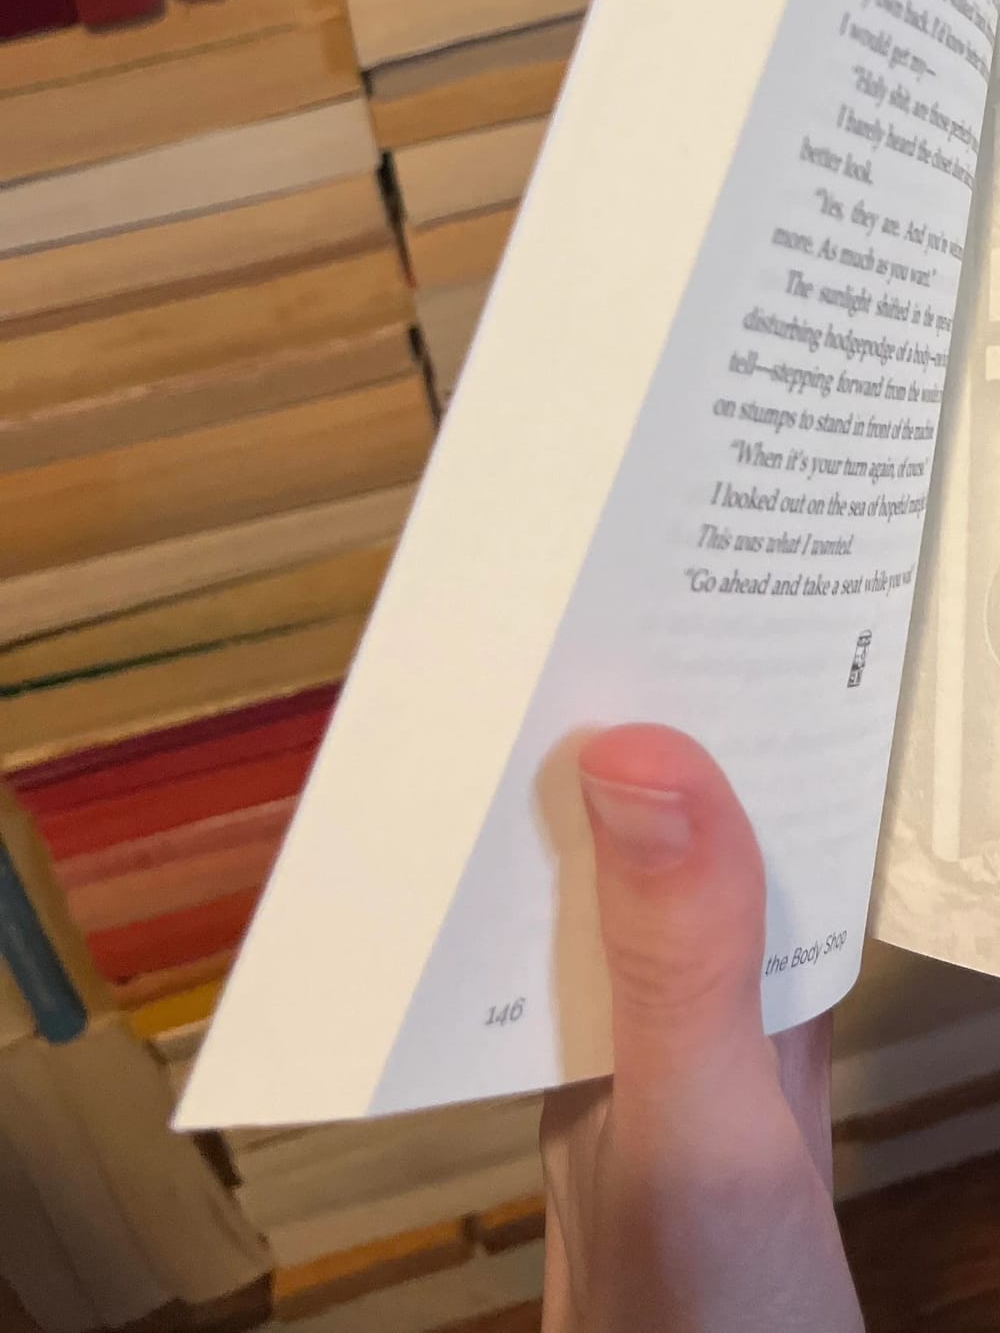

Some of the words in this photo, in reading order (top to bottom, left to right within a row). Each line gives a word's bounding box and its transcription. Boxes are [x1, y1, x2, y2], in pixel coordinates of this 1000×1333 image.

[786, 269, 814, 299] The
[819, 284, 873, 318] sunlight
[742, 306, 823, 353] disturbing
[822, 322, 897, 367] hodgepodge
[836, 369, 885, 397] forward
[884, 375, 907, 402] from
[906, 379, 921, 403] the
[713, 398, 737, 417] on
[739, 401, 797, 434] stumps
[798, 409, 814, 431] to
[816, 412, 852, 435] stand
[851, 417, 865, 437] in
[865, 415, 892, 439] front
[891, 417, 902, 440] of
[730, 438, 784, 468] “When
[785, 448, 810, 473] it’s
[806, 456, 844, 481] your
[842, 456, 868, 478] turn
[867, 457, 896, 486] again,
[710, 481, 722, 506] I
[721, 486, 781, 512] looked
[780, 497, 807, 516] out
[806, 498, 826, 516] on
[827, 490, 847, 518] the
[848, 499, 867, 518] sea
[866, 493, 881, 518] of
[696, 523, 731, 552] This
[733, 532, 764, 553] was
[764, 530, 801, 555] what
[800, 532, 813, 556] I
[683, 568, 717, 594] “Go
[718, 568, 771, 596] ahead
[770, 573, 803, 597] and
[802, 573, 830, 597] take
[830, 579, 840, 596] a
[839, 576, 863, 596] seat
[863, 569, 888, 594] while
[763, 952, 789, 977] the
[790, 940, 826, 968] Body
[823, 928, 848, 957] Shop
[483, 996, 527, 1028] 146
